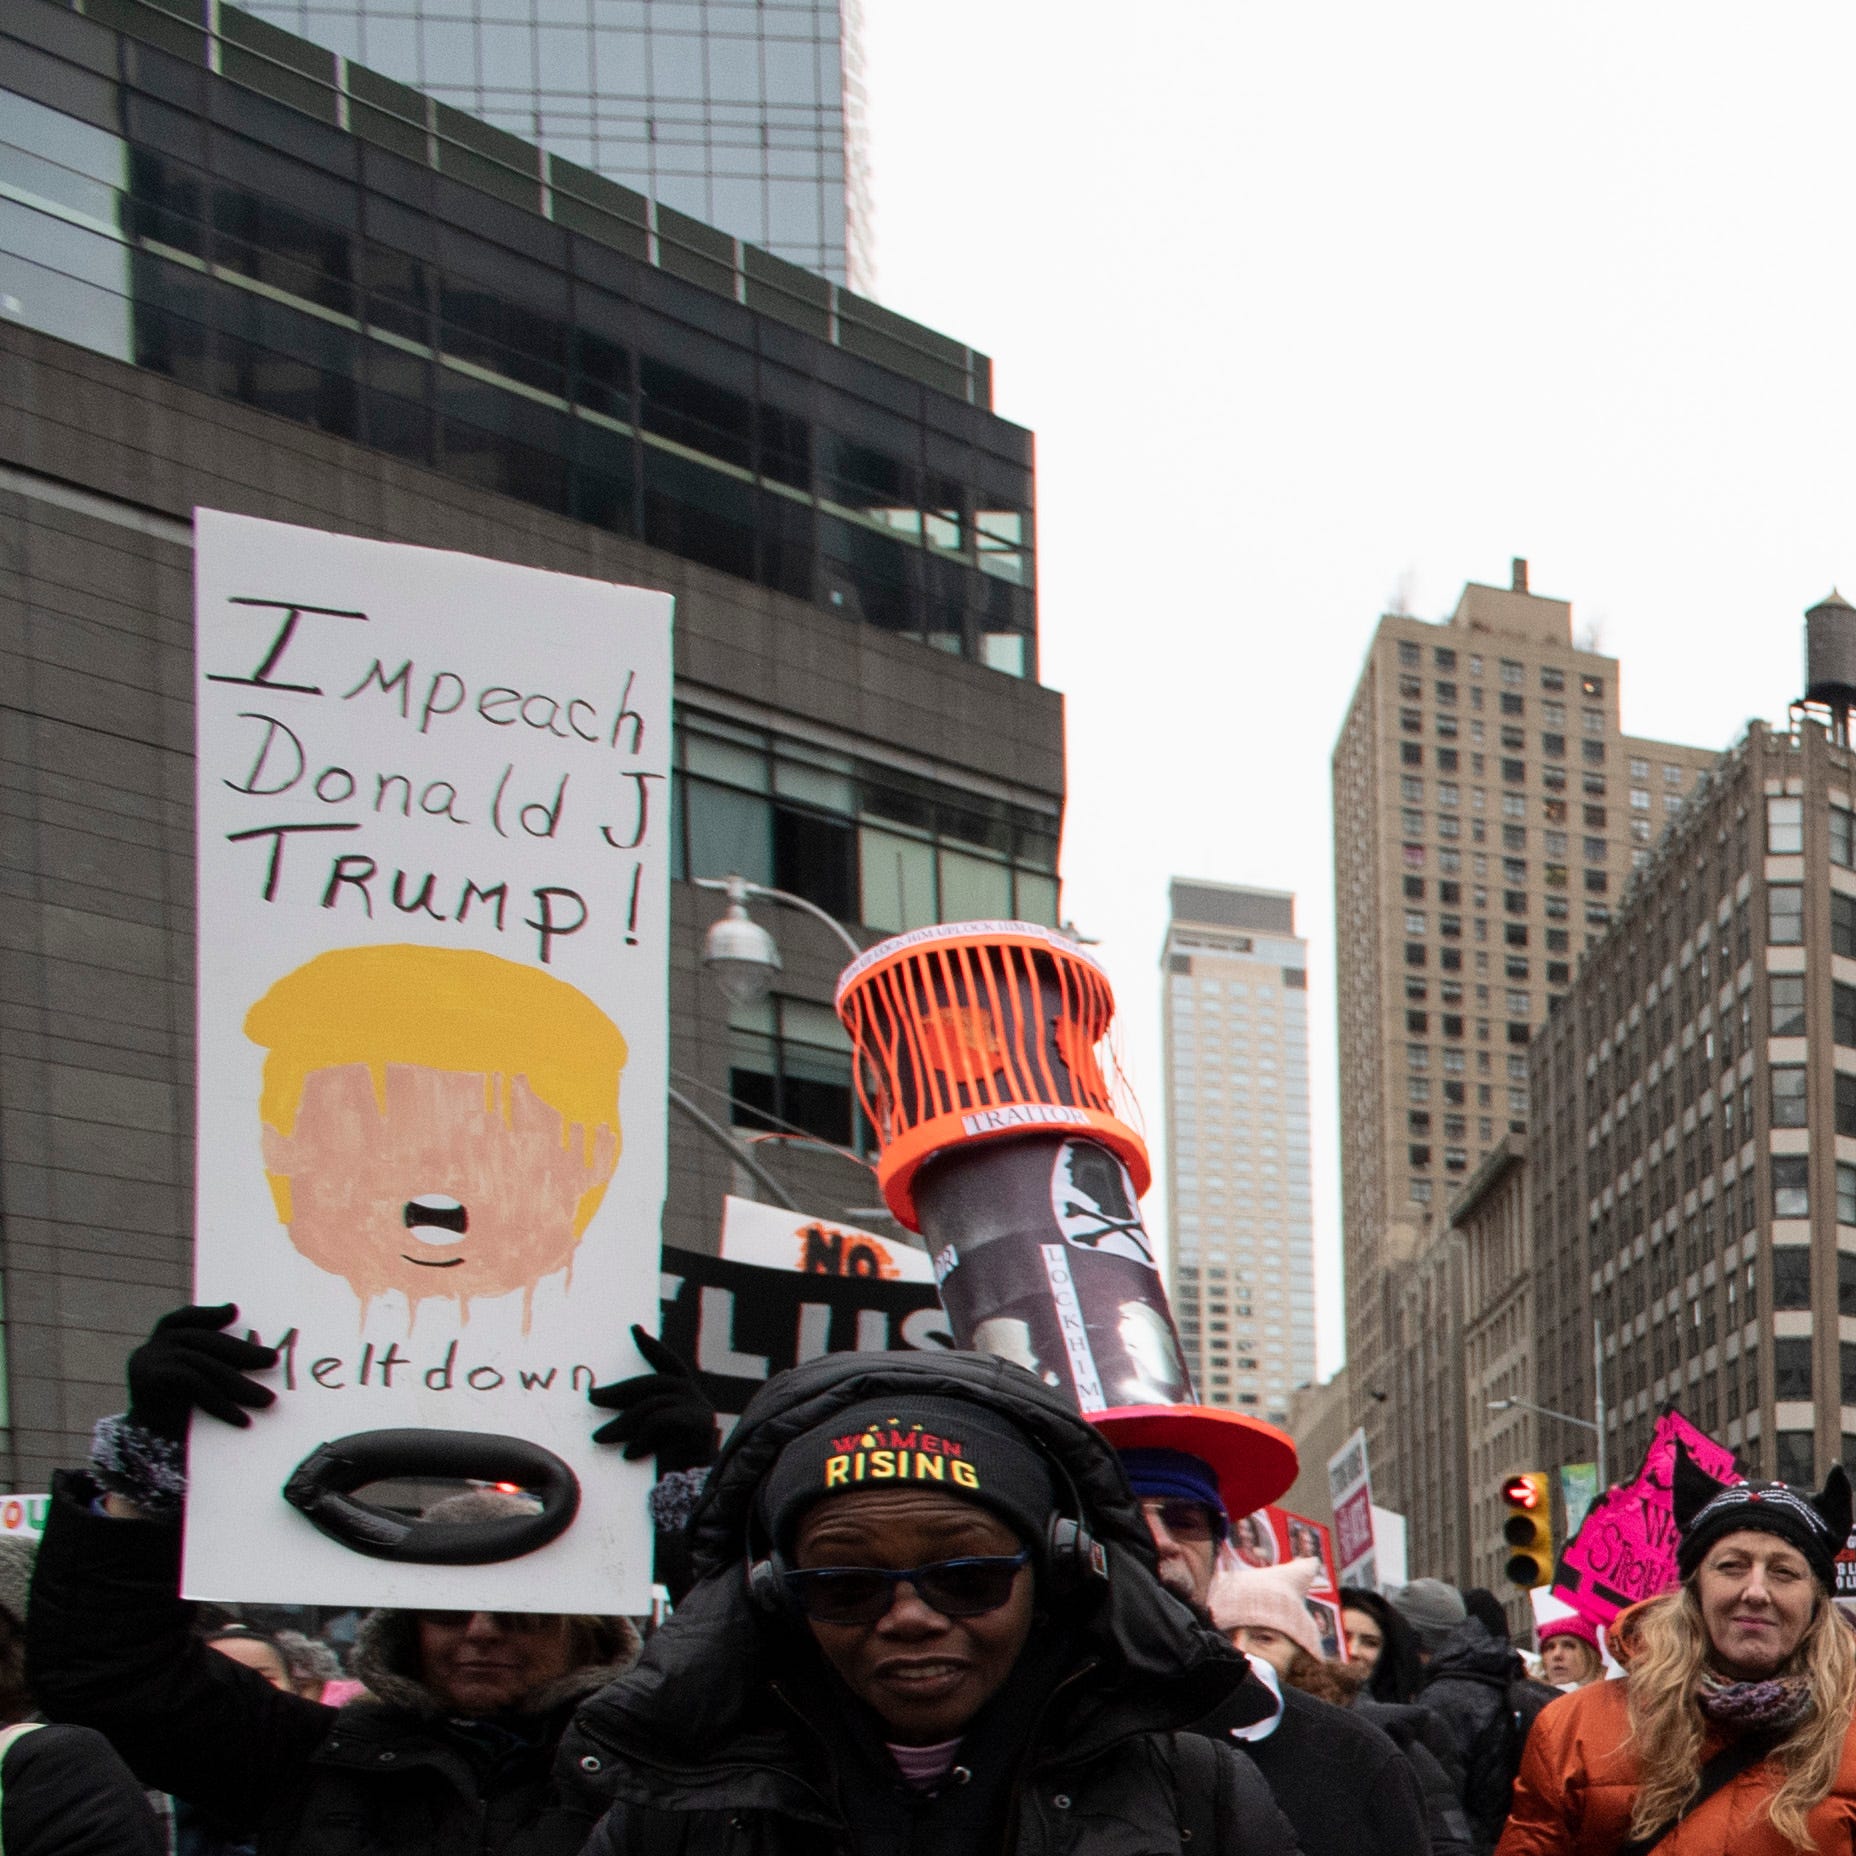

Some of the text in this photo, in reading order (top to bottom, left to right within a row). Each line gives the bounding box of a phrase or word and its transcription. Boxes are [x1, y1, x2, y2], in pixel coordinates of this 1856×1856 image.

[223, 713, 666, 850] Donald J
[966, 1106, 1089, 1133] TRAITOR
[825, 1450, 981, 1490] RISING
